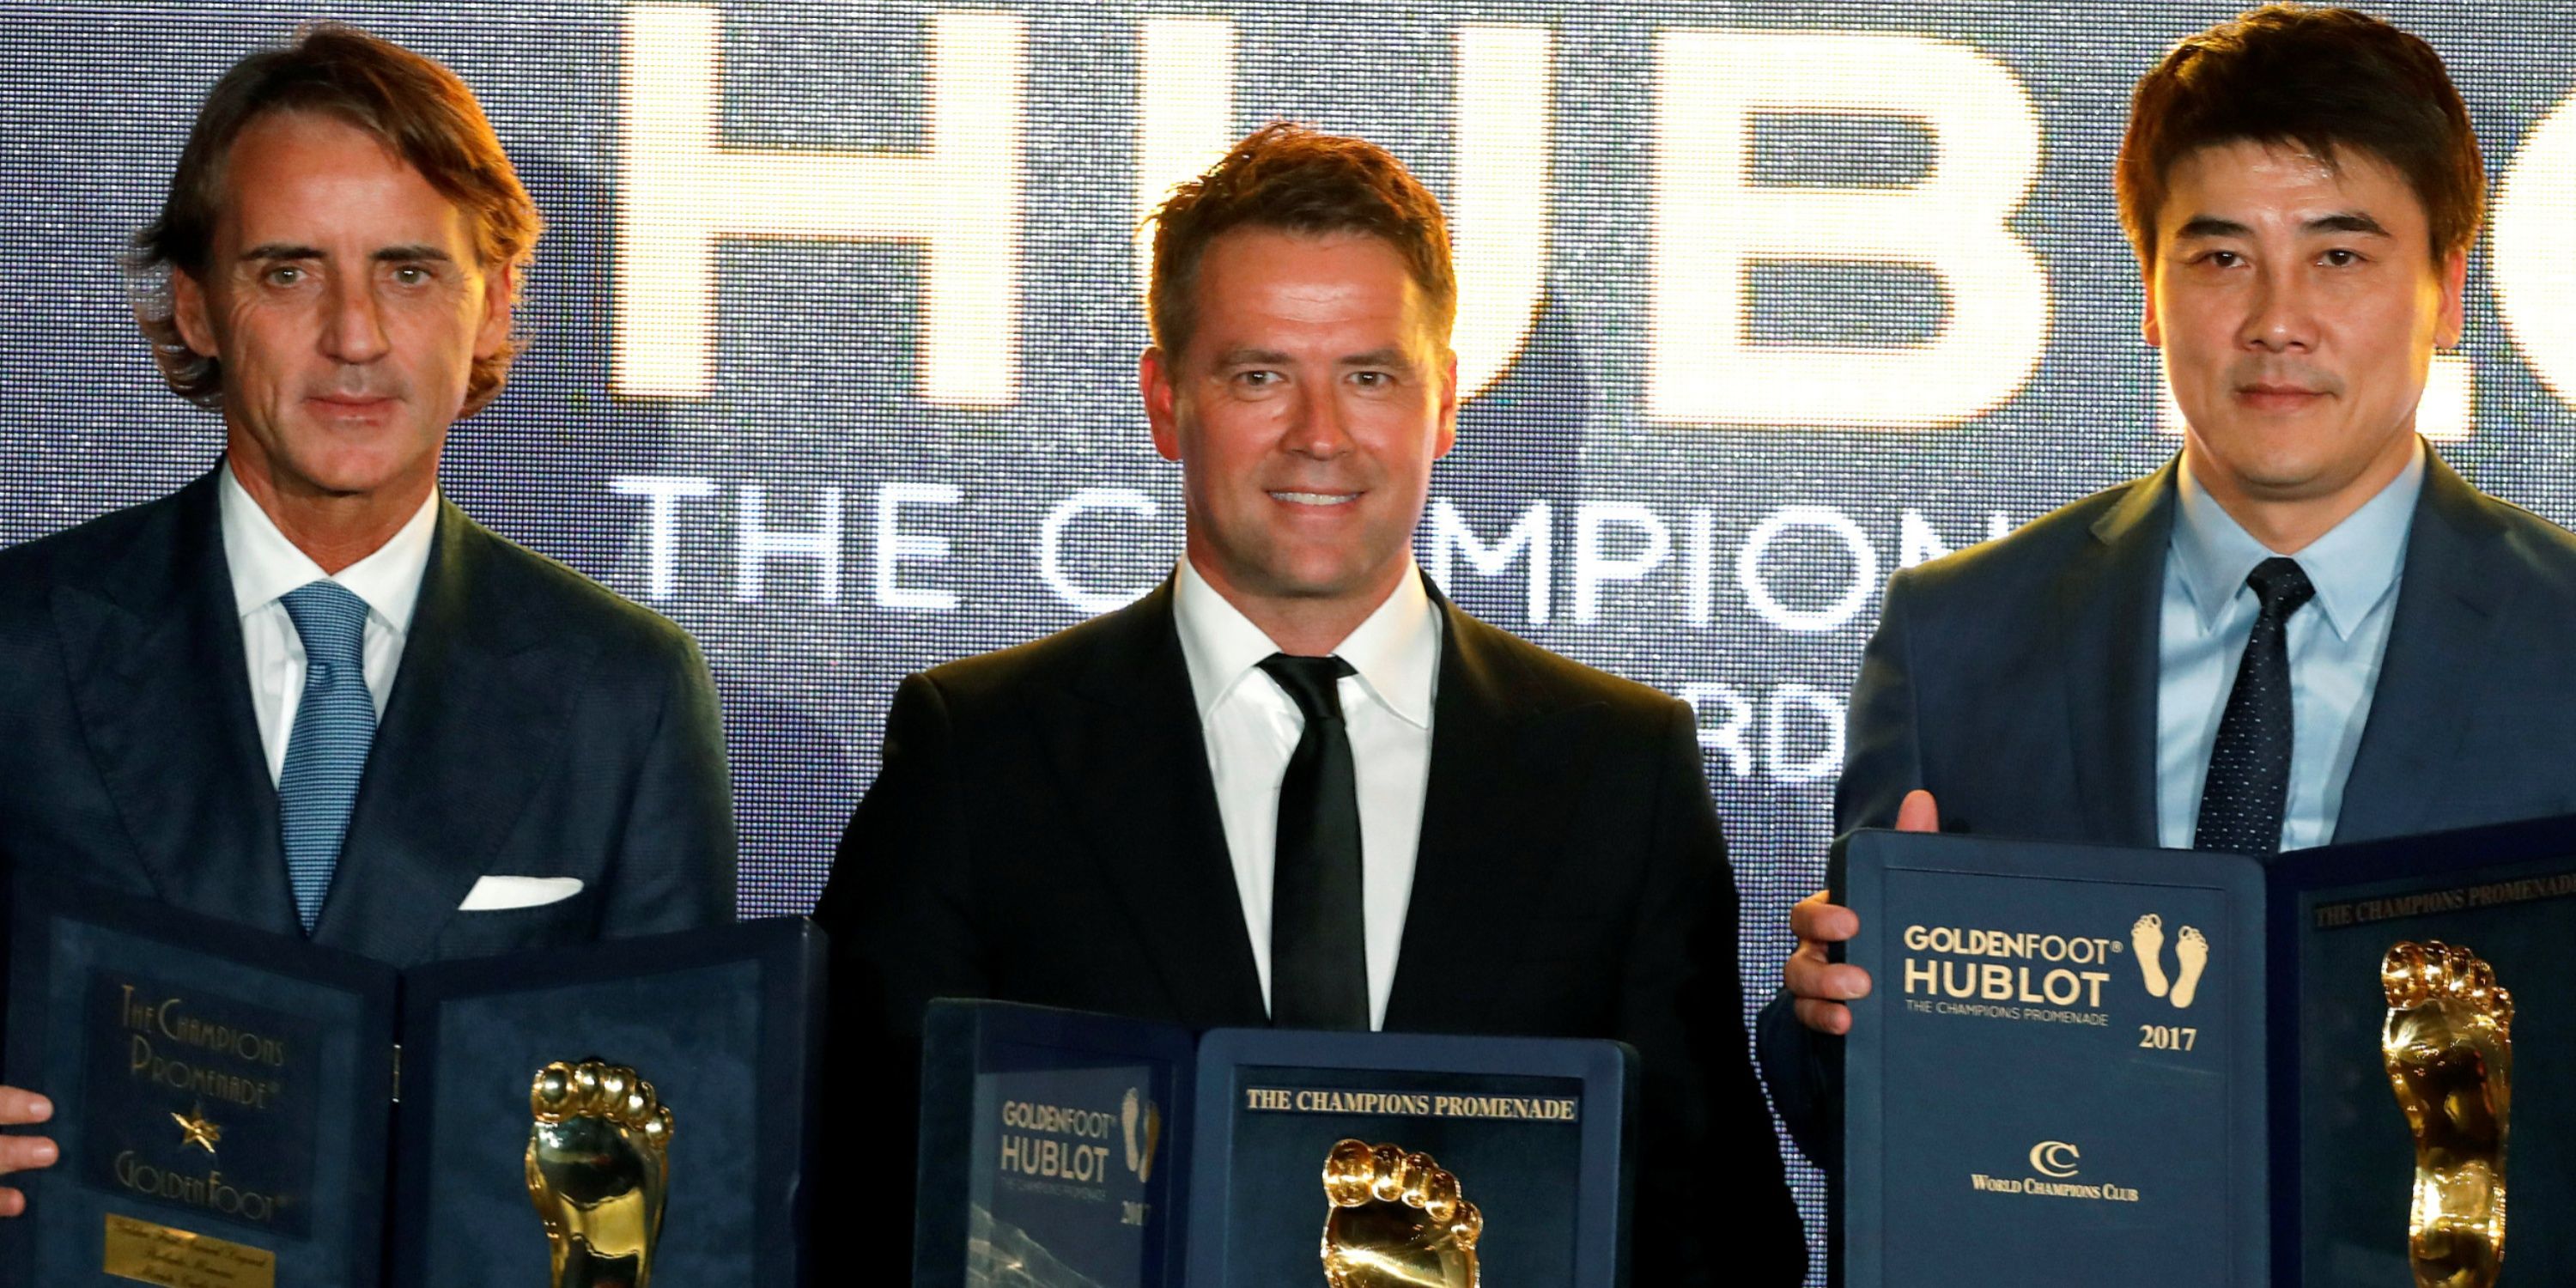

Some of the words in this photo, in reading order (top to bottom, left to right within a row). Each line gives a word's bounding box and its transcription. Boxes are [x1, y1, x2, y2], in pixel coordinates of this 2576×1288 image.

[609, 475, 966, 610] THE
[2315, 904, 2353, 927] THE
[2355, 888, 2464, 922] CHAMPIONS
[1904, 957, 2110, 1007] HUBLOT
[1905, 999, 1933, 1013] THE
[1935, 1001, 2020, 1020] CHAMPIONS
[2023, 1008, 2109, 1026] PROMENADE
[2138, 1024, 2197, 1051] 2017
[1246, 1089, 1291, 1109] THE
[1296, 1091, 1429, 1115] CHAMPIONS
[1433, 1096, 1575, 1120] PROMENADE
[1000, 1134, 1109, 1182] HUBLOT
[1971, 1174, 2022, 1194] WORLD
[2023, 1177, 2101, 1199] CHAMPIONS
[2103, 1182, 2139, 1202] CLUB
